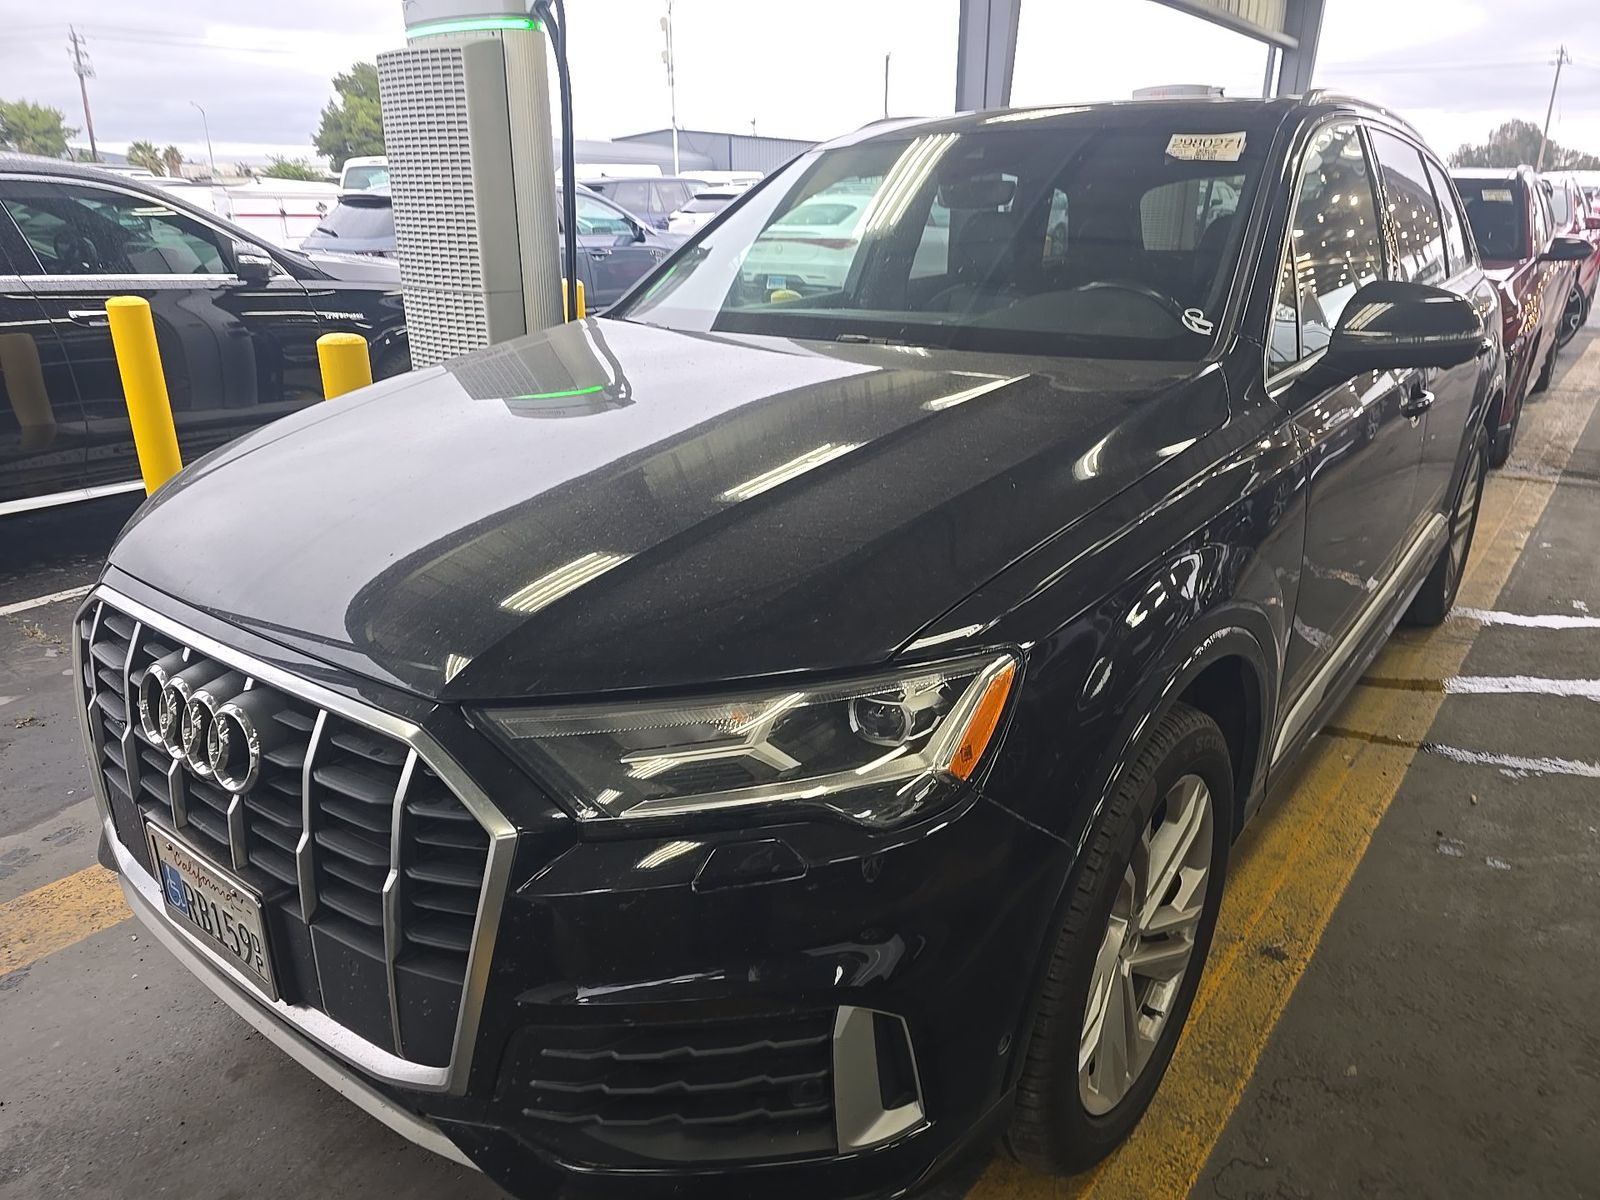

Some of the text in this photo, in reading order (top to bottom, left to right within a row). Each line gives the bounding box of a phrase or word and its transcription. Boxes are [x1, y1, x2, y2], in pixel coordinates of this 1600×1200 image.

[1172, 136, 1242, 149] 2980271
[173, 850, 237, 902] California
[181, 879, 252, 965] RB159
